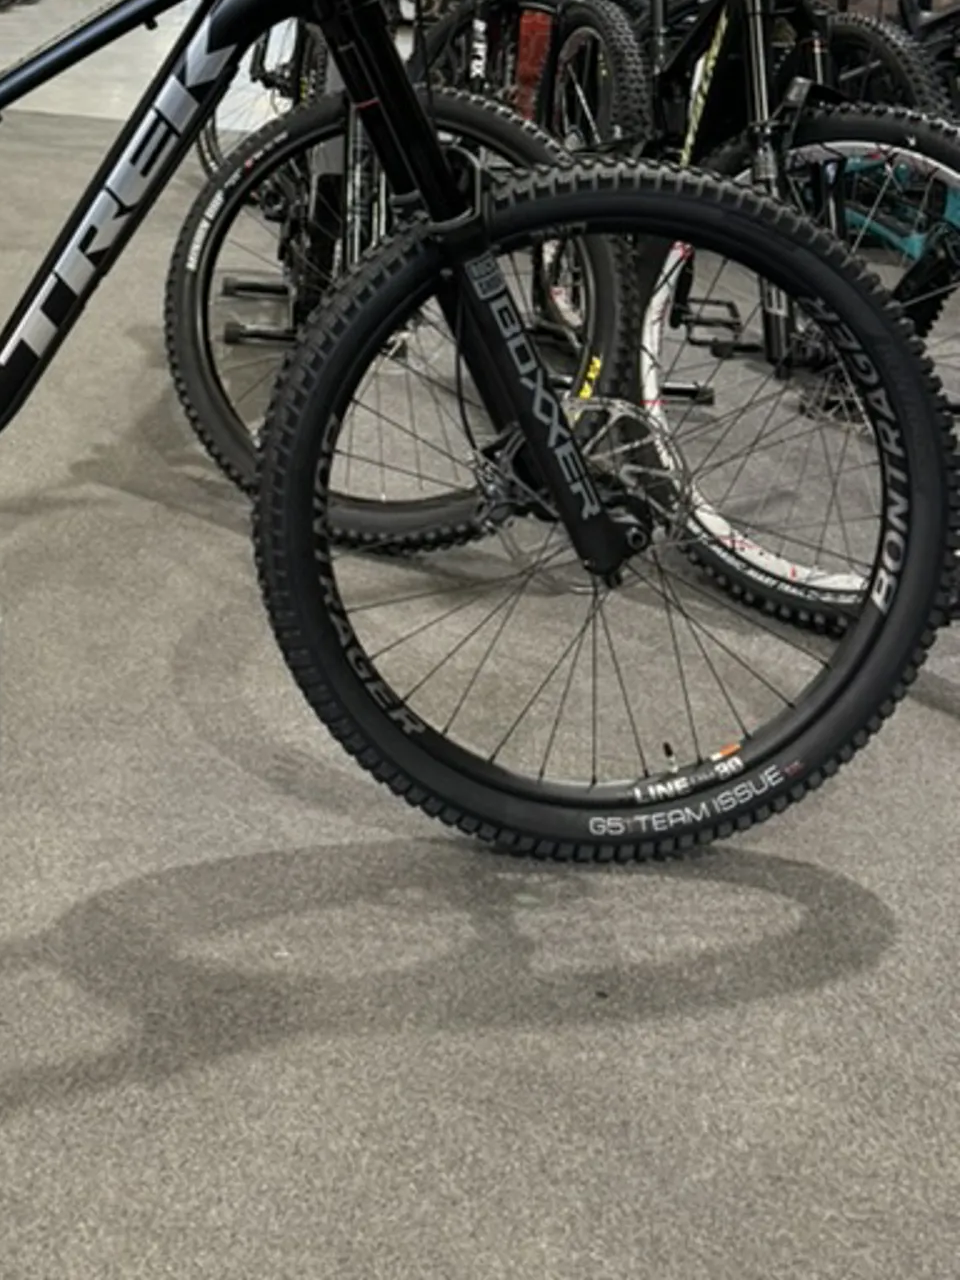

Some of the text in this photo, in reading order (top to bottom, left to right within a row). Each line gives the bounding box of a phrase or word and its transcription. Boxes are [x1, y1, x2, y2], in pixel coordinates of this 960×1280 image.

[490, 292, 603, 520] BOXER
[796, 296, 906, 616] BONTRAGER
[589, 816, 627, 836] G5
[634, 801, 711, 833] TEAM
[711, 764, 785, 813] ISSUE
[633, 774, 690, 803] LINE
